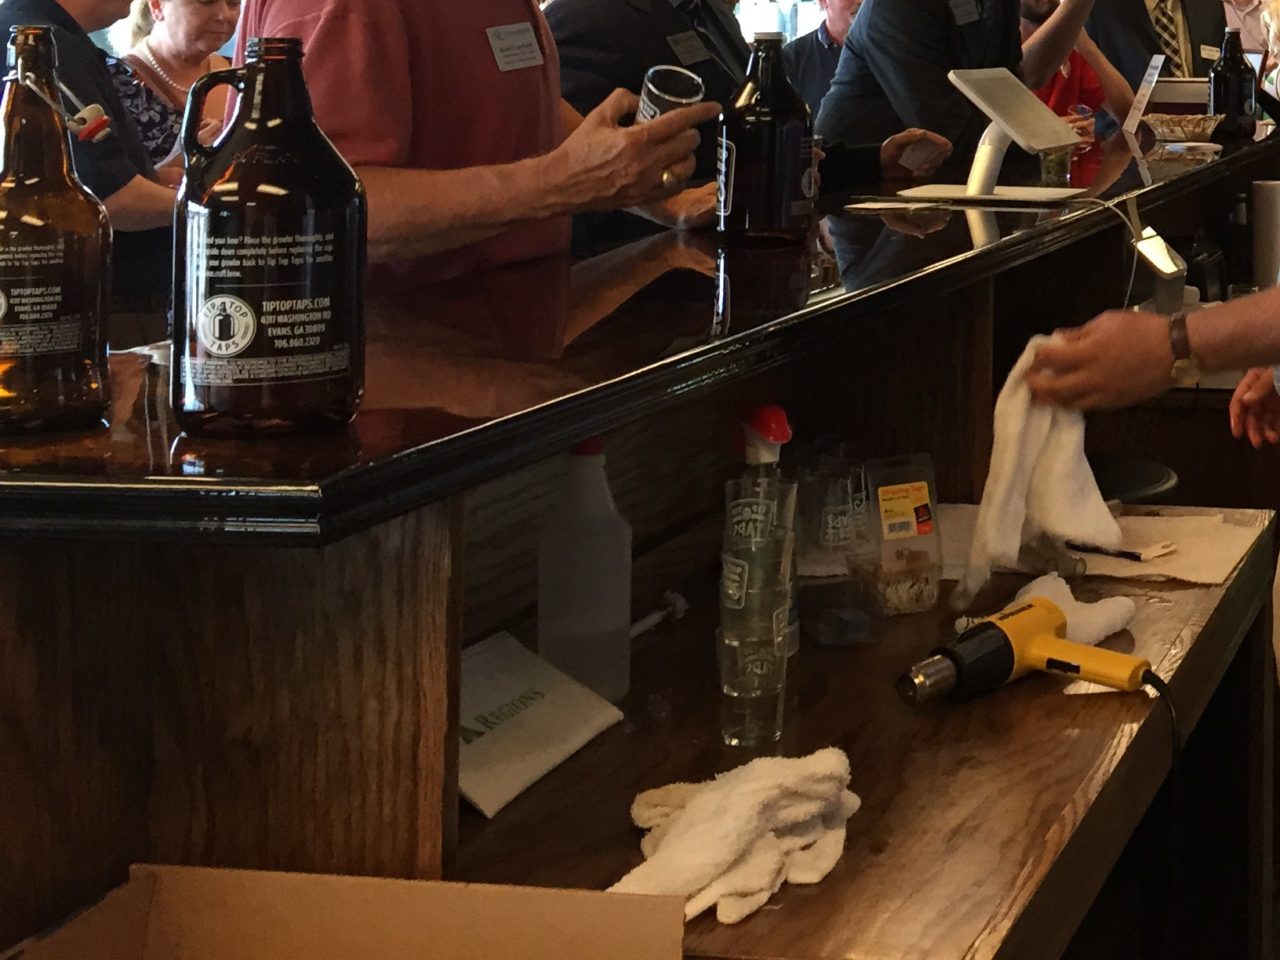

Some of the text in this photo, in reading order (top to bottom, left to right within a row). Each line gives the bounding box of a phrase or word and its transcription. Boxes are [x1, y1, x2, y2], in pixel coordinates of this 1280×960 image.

[229, 301, 248, 318] TOP
[262, 297, 331, 312] TIPTOPTAPS.COM
[294, 325, 304, 335] GA
[210, 340, 239, 351] TAPS
